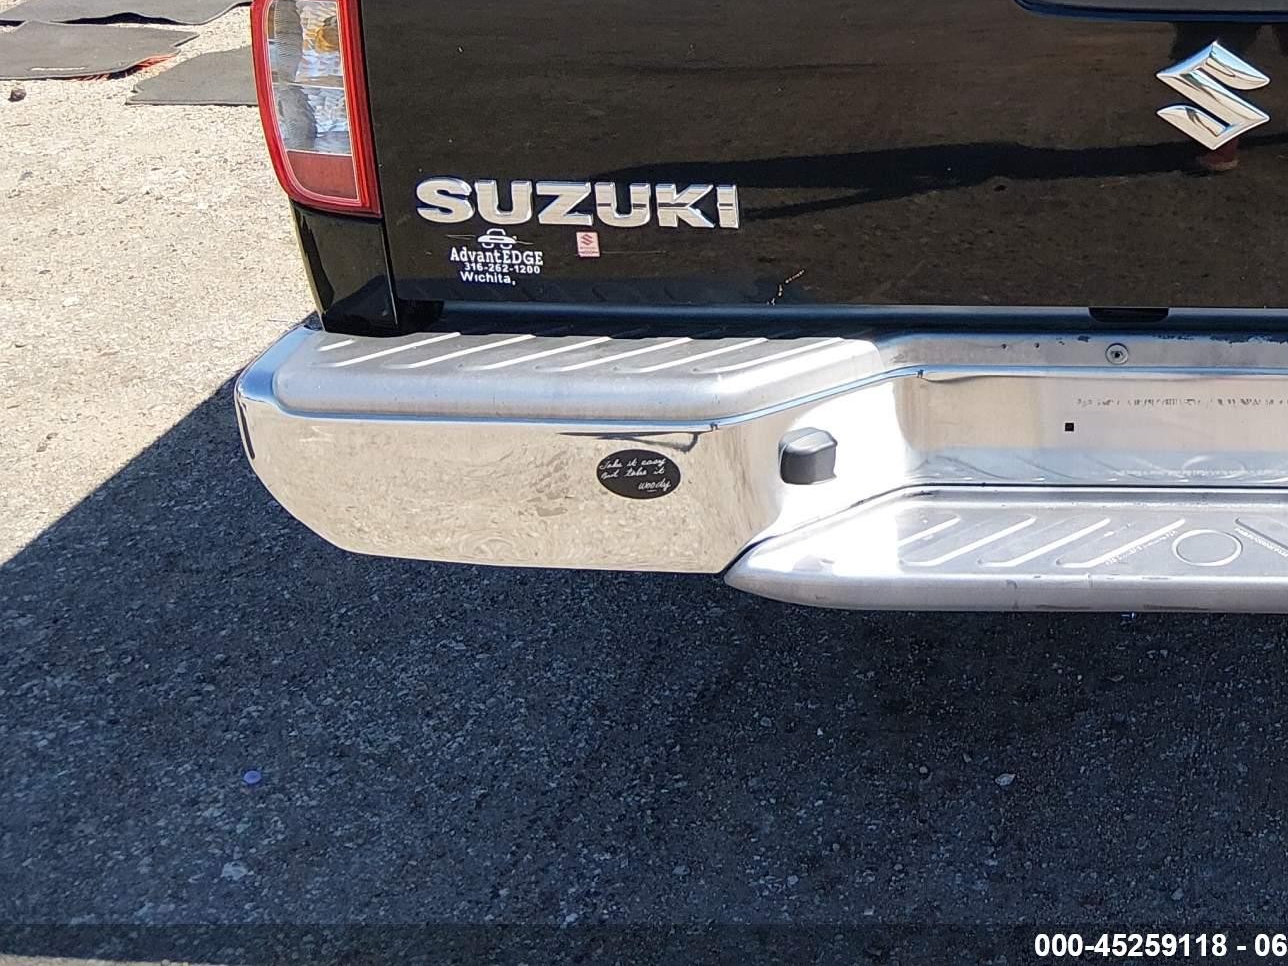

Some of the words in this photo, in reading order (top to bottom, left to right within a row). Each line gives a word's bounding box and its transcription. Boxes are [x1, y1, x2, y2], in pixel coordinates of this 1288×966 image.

[416, 177, 740, 229] SUZUKI
[450, 246, 544, 266] AdvantEDGE
[464, 262, 541, 274] 316-262-1200
[460, 271, 516, 286] Wichita,
[627, 458, 637, 466] it
[641, 458, 666, 467] easy
[624, 467, 647, 477] take
[653, 466, 664, 475] it
